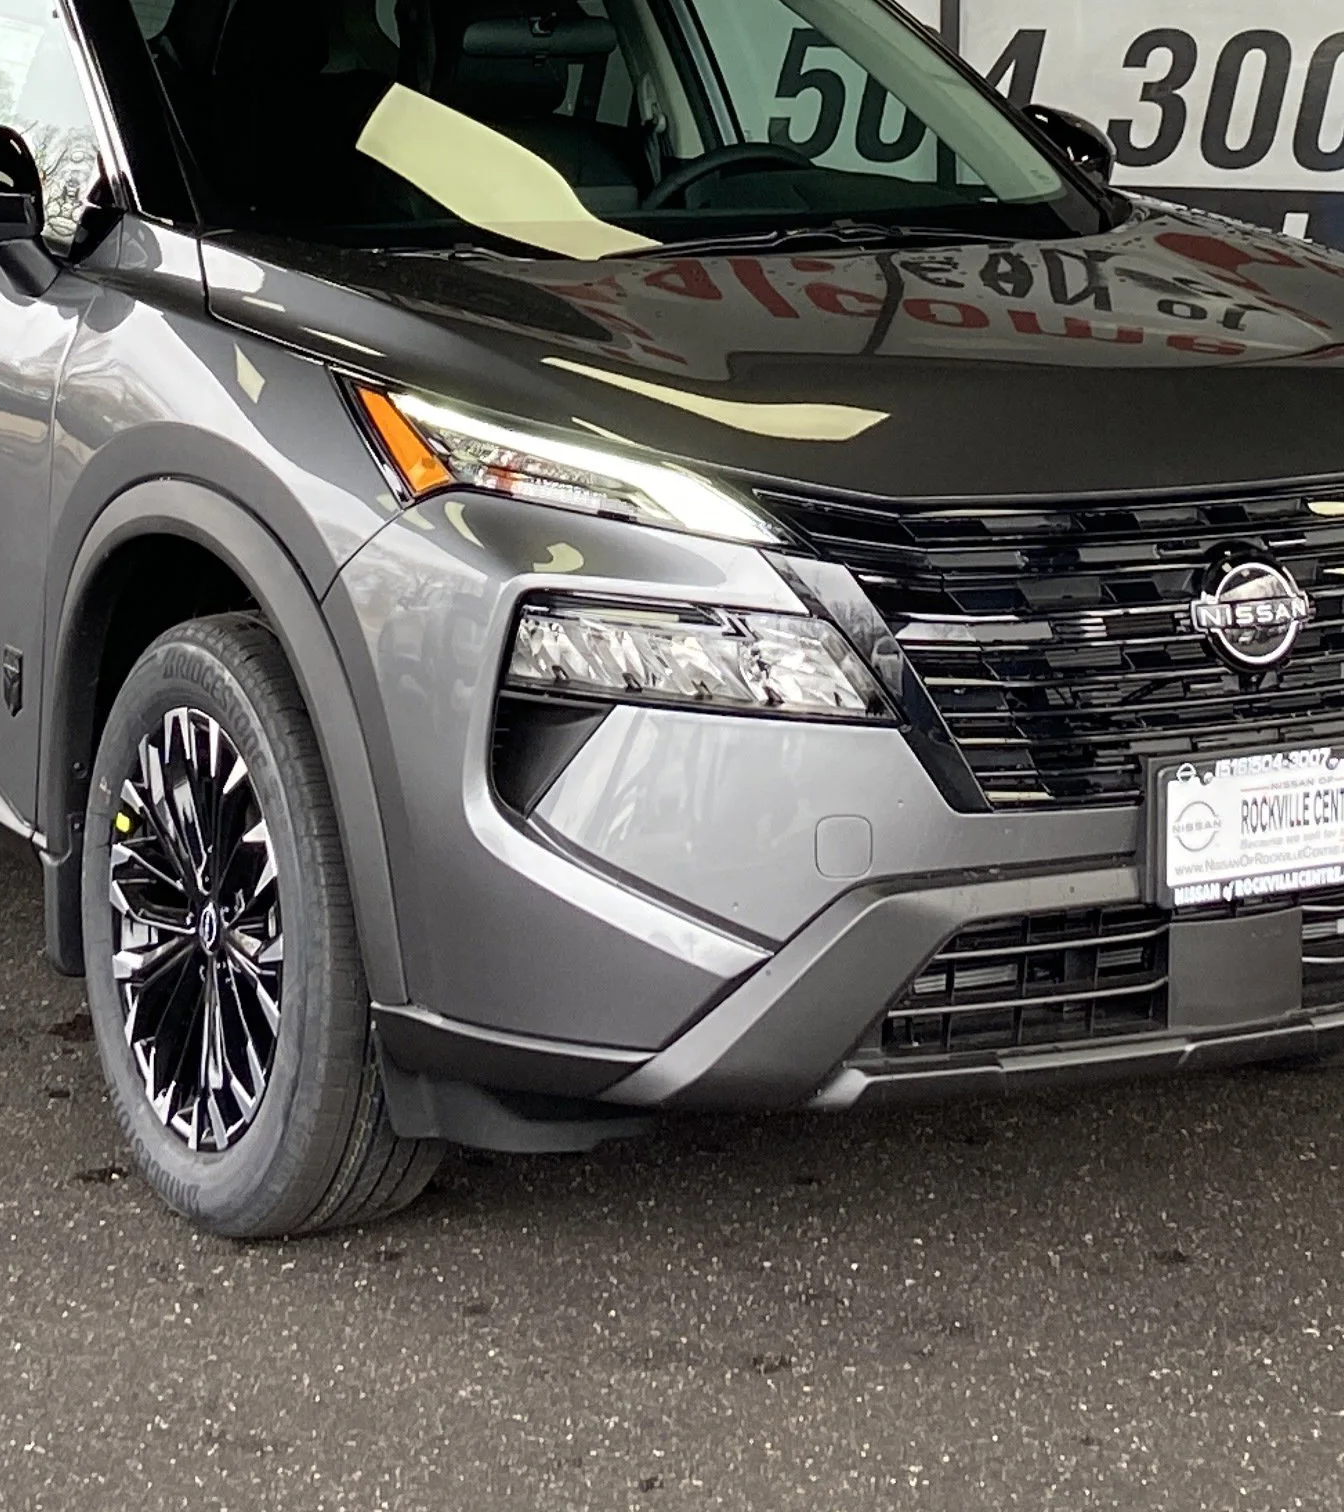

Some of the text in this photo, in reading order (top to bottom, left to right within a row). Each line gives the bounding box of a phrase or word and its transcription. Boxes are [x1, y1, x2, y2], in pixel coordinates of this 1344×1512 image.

[1199, 596, 1306, 626] NISSAN
[1172, 819, 1221, 834] NISSAN
[1240, 791, 1310, 834] ROCKVILLE
